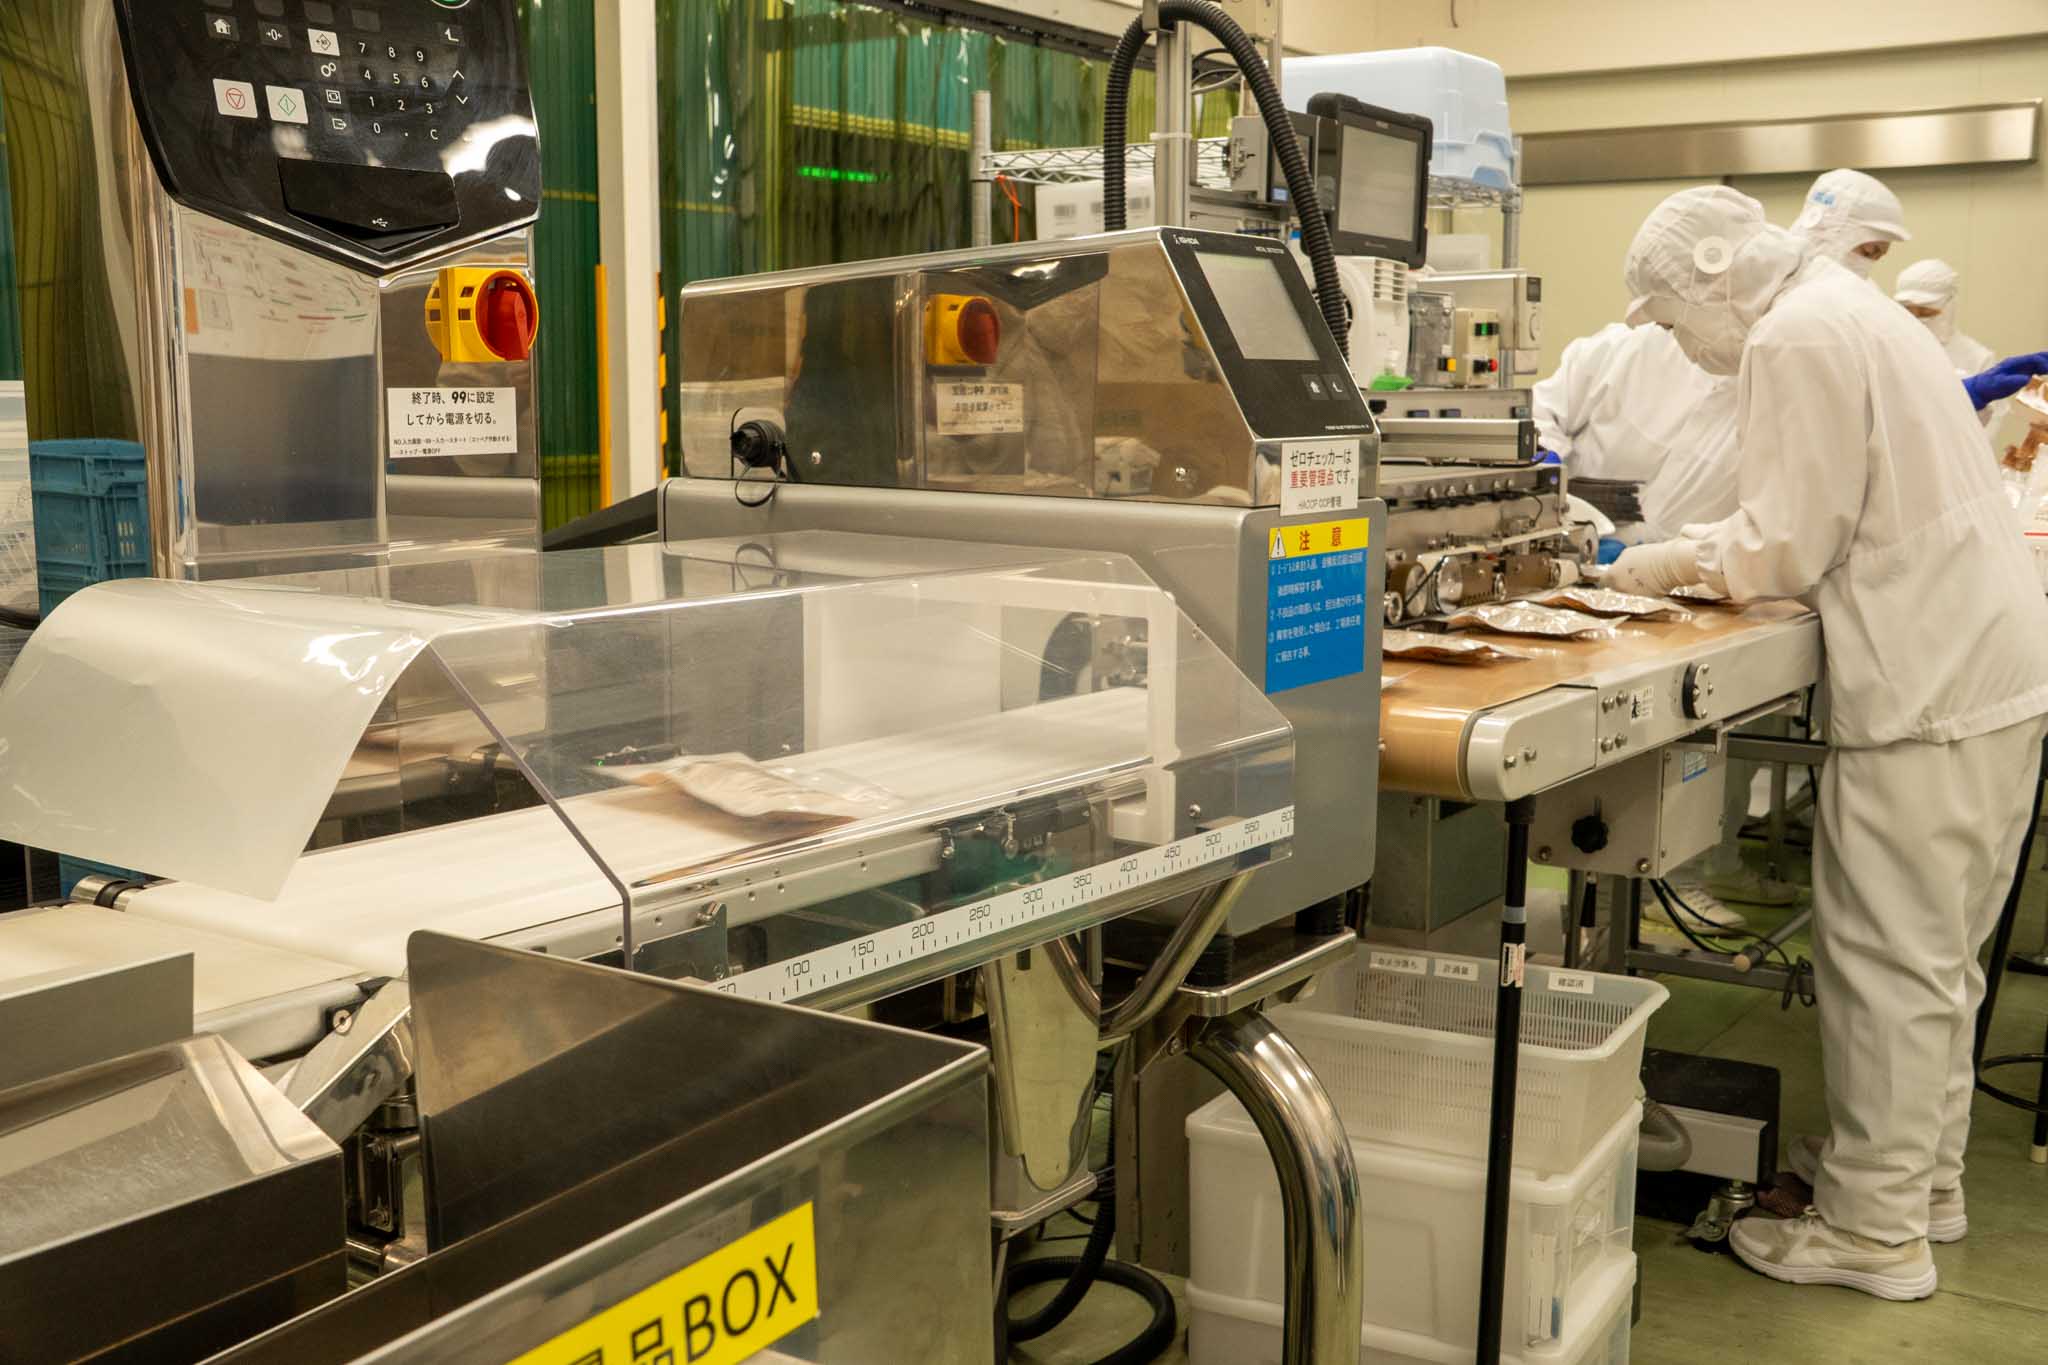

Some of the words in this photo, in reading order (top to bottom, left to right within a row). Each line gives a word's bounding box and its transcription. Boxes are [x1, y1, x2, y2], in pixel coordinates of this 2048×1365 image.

[358, 42, 367, 53] 7
[388, 46, 396, 58] 8
[416, 50, 424, 62] 9
[364, 69, 372, 81] 4
[392, 73, 400, 84] 5
[421, 76, 429, 88] 6
[369, 96, 375, 107] 1
[397, 99, 405, 111] 2
[425, 103, 433, 114] 3
[373, 122, 381, 134] 0
[430, 129, 438, 140] C
[407, 412, 497, 425] してから電源を切る。
[1290, 448, 1352, 467] ゼロチェッカーは
[785, 959, 810, 978] 100
[851, 940, 875, 958] 150
[911, 921, 935, 939] 200
[969, 904, 991, 922] 250
[1023, 888, 1043, 905] 300
[1073, 873, 1092, 889] 350
[1120, 858, 1138, 873] 400
[1163, 845, 1181, 859] 450
[1205, 832, 1222, 847] 500
[1244, 820, 1260, 834] 550
[567, 1243, 798, 1365] 品BOX
